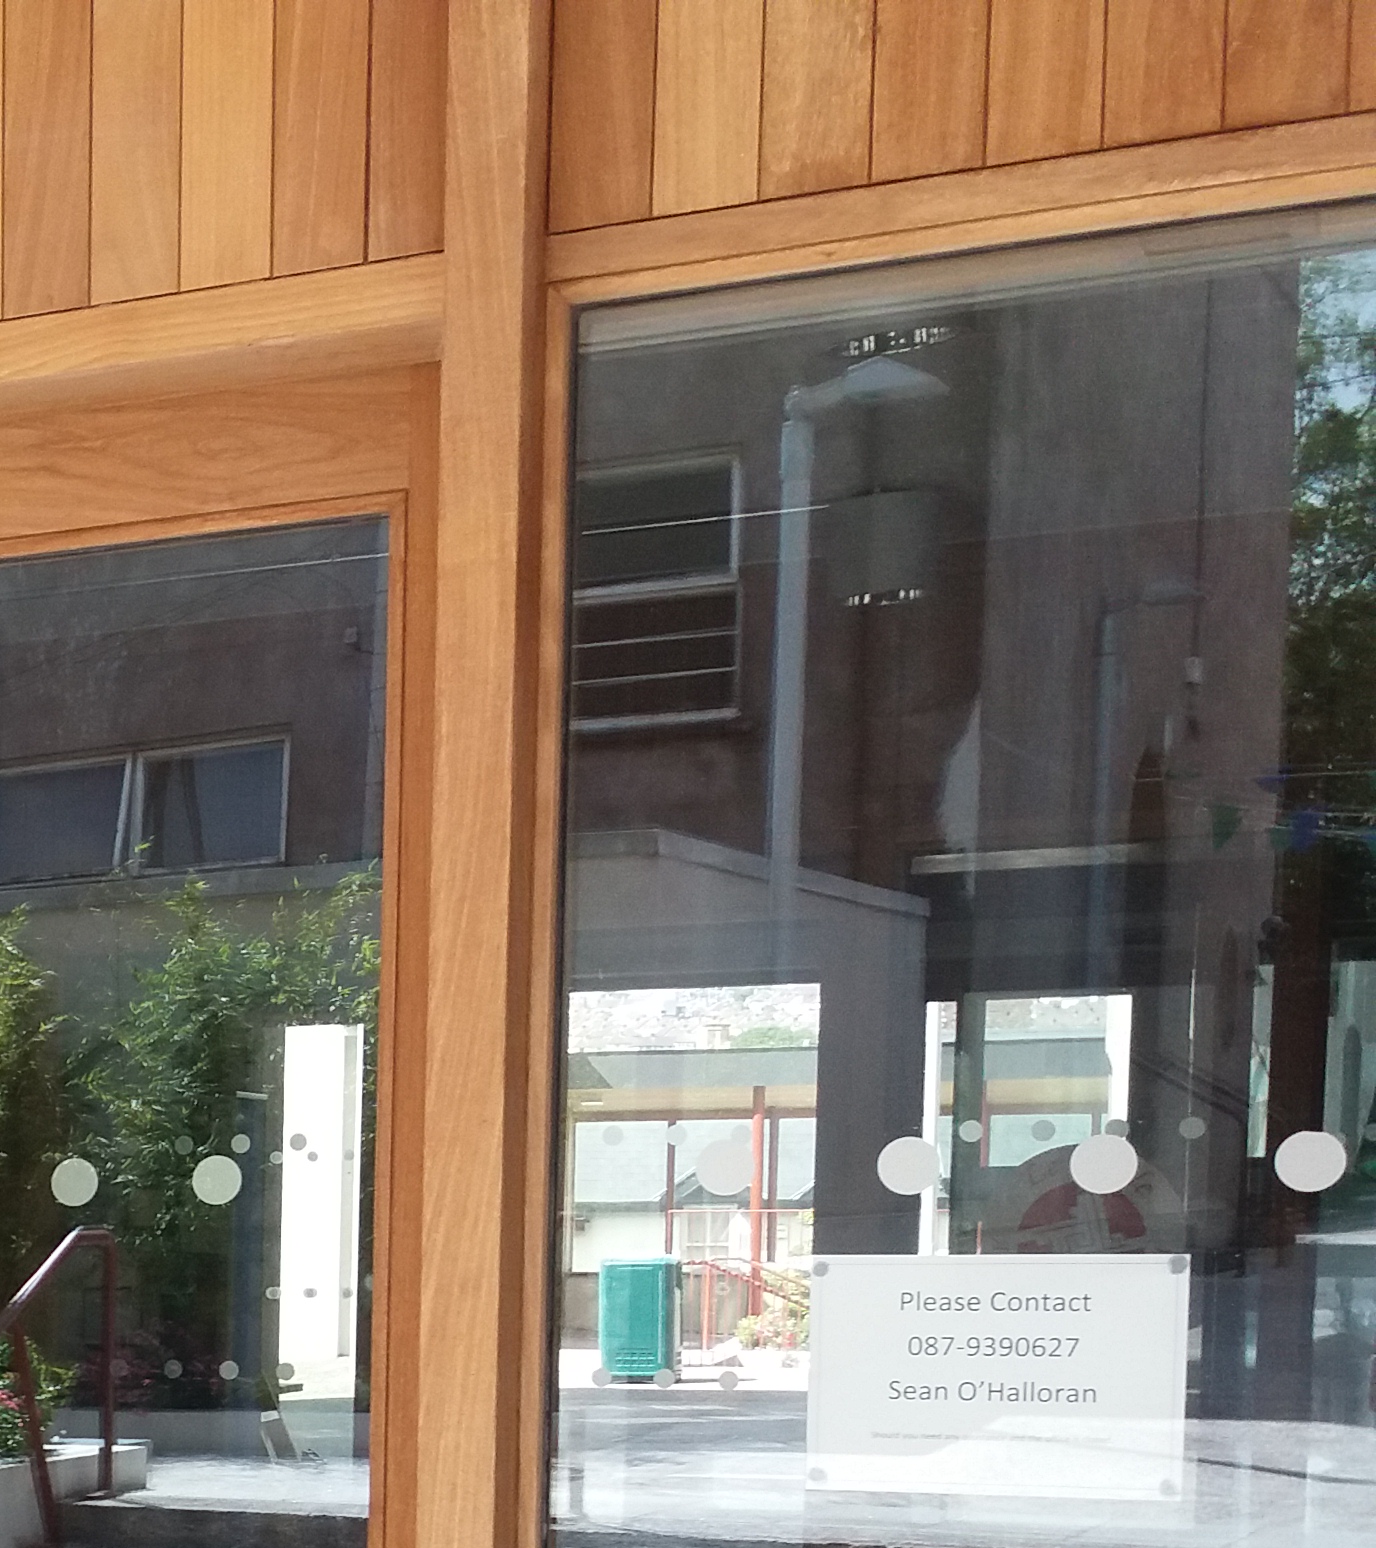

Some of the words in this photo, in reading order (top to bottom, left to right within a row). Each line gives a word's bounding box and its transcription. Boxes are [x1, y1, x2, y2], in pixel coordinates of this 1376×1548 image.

[900, 1290, 981, 1312] Please
[990, 1290, 1093, 1312] Contact
[907, 1336, 1080, 1358] 087-9390627
[888, 1380, 948, 1401] Sean
[958, 1380, 1097, 1404] O’Halloran
